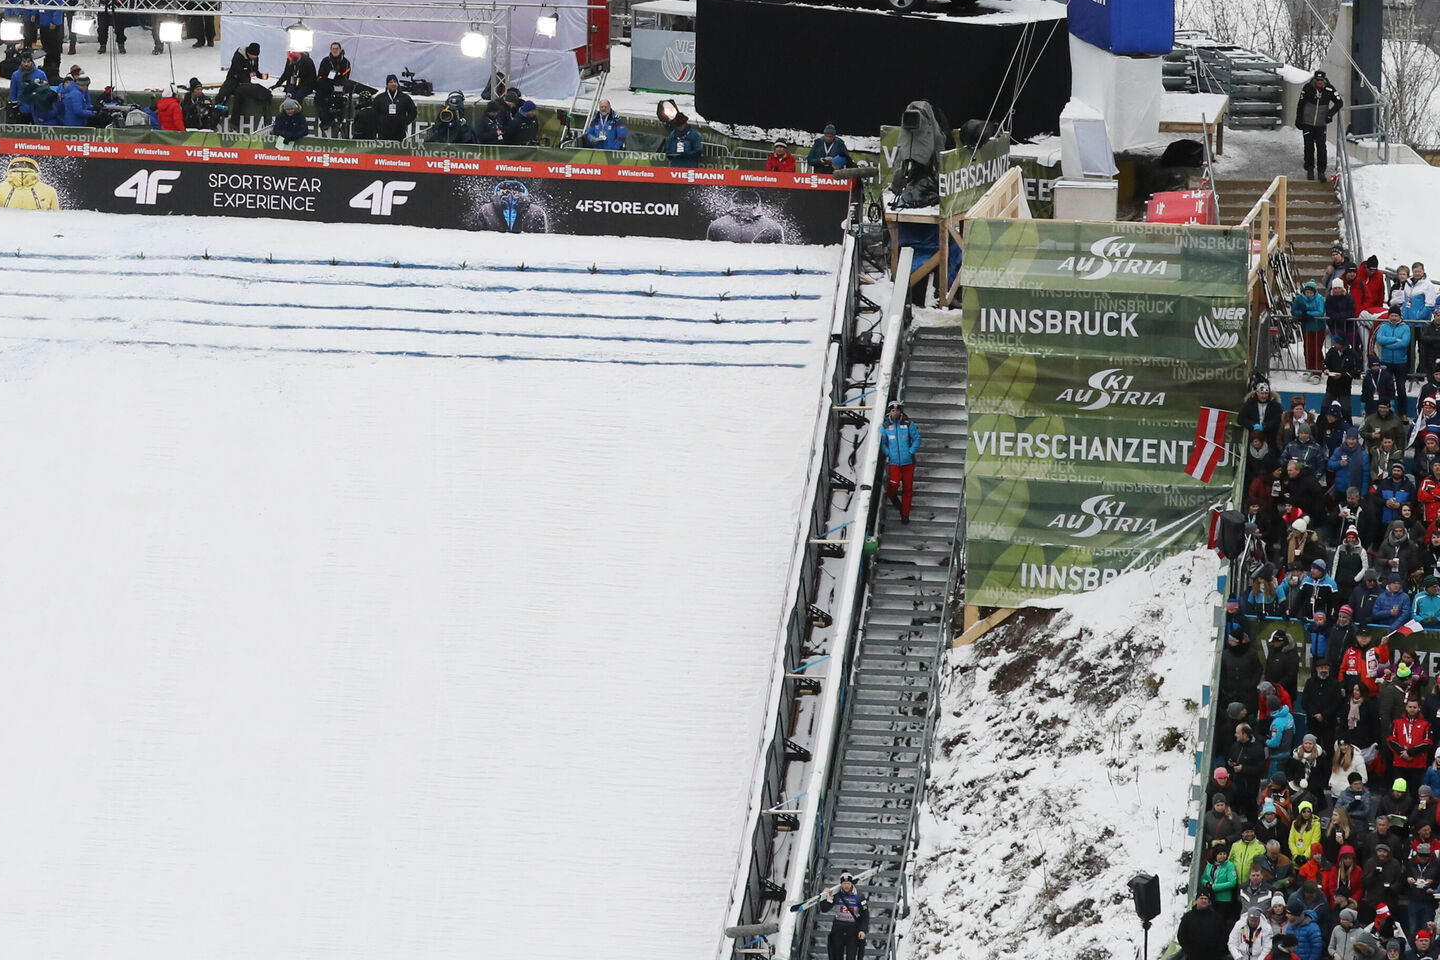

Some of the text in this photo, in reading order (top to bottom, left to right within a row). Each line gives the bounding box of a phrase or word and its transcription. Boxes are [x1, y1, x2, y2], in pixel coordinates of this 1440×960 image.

[676, 41, 696, 53] VIE
[66, 143, 119, 155] VIESSMANN
[134, 148, 170, 156] #Winterfans
[186, 148, 238, 160] VIESSMANN
[305, 154, 358, 166] VIESSMANN
[612, 150, 666, 161] INNSBRU
[375, 159, 410, 167] #Winterfans
[426, 160, 479, 172] VIESSMANN
[495, 164, 532, 173] #Winterfans
[548, 165, 601, 177] VIESSMANN
[618, 170, 654, 178] #Winterfans
[670, 170, 724, 182] VIESSMANN
[208, 173, 321, 193] SPORTSWEAR
[740, 174, 777, 183] #Winterfans
[113, 169, 181, 205] 4F
[213, 193, 316, 212] EXPERIENCE
[349, 180, 416, 216] 4F
[575, 198, 679, 217] 4FSTORE.COM
[1175, 236, 1247, 250] INNSBRUC
[1057, 256, 1168, 280] AUSTRIA
[1094, 299, 1174, 314] INNSBRUCK
[1212, 307, 1246, 320] VIER
[980, 308, 1139, 338] INNSBRUCK
[1173, 367, 1244, 381] INNSBRUC
[1056, 388, 1166, 410] AUSTRIA
[1047, 512, 1158, 538] AUSTRIA
